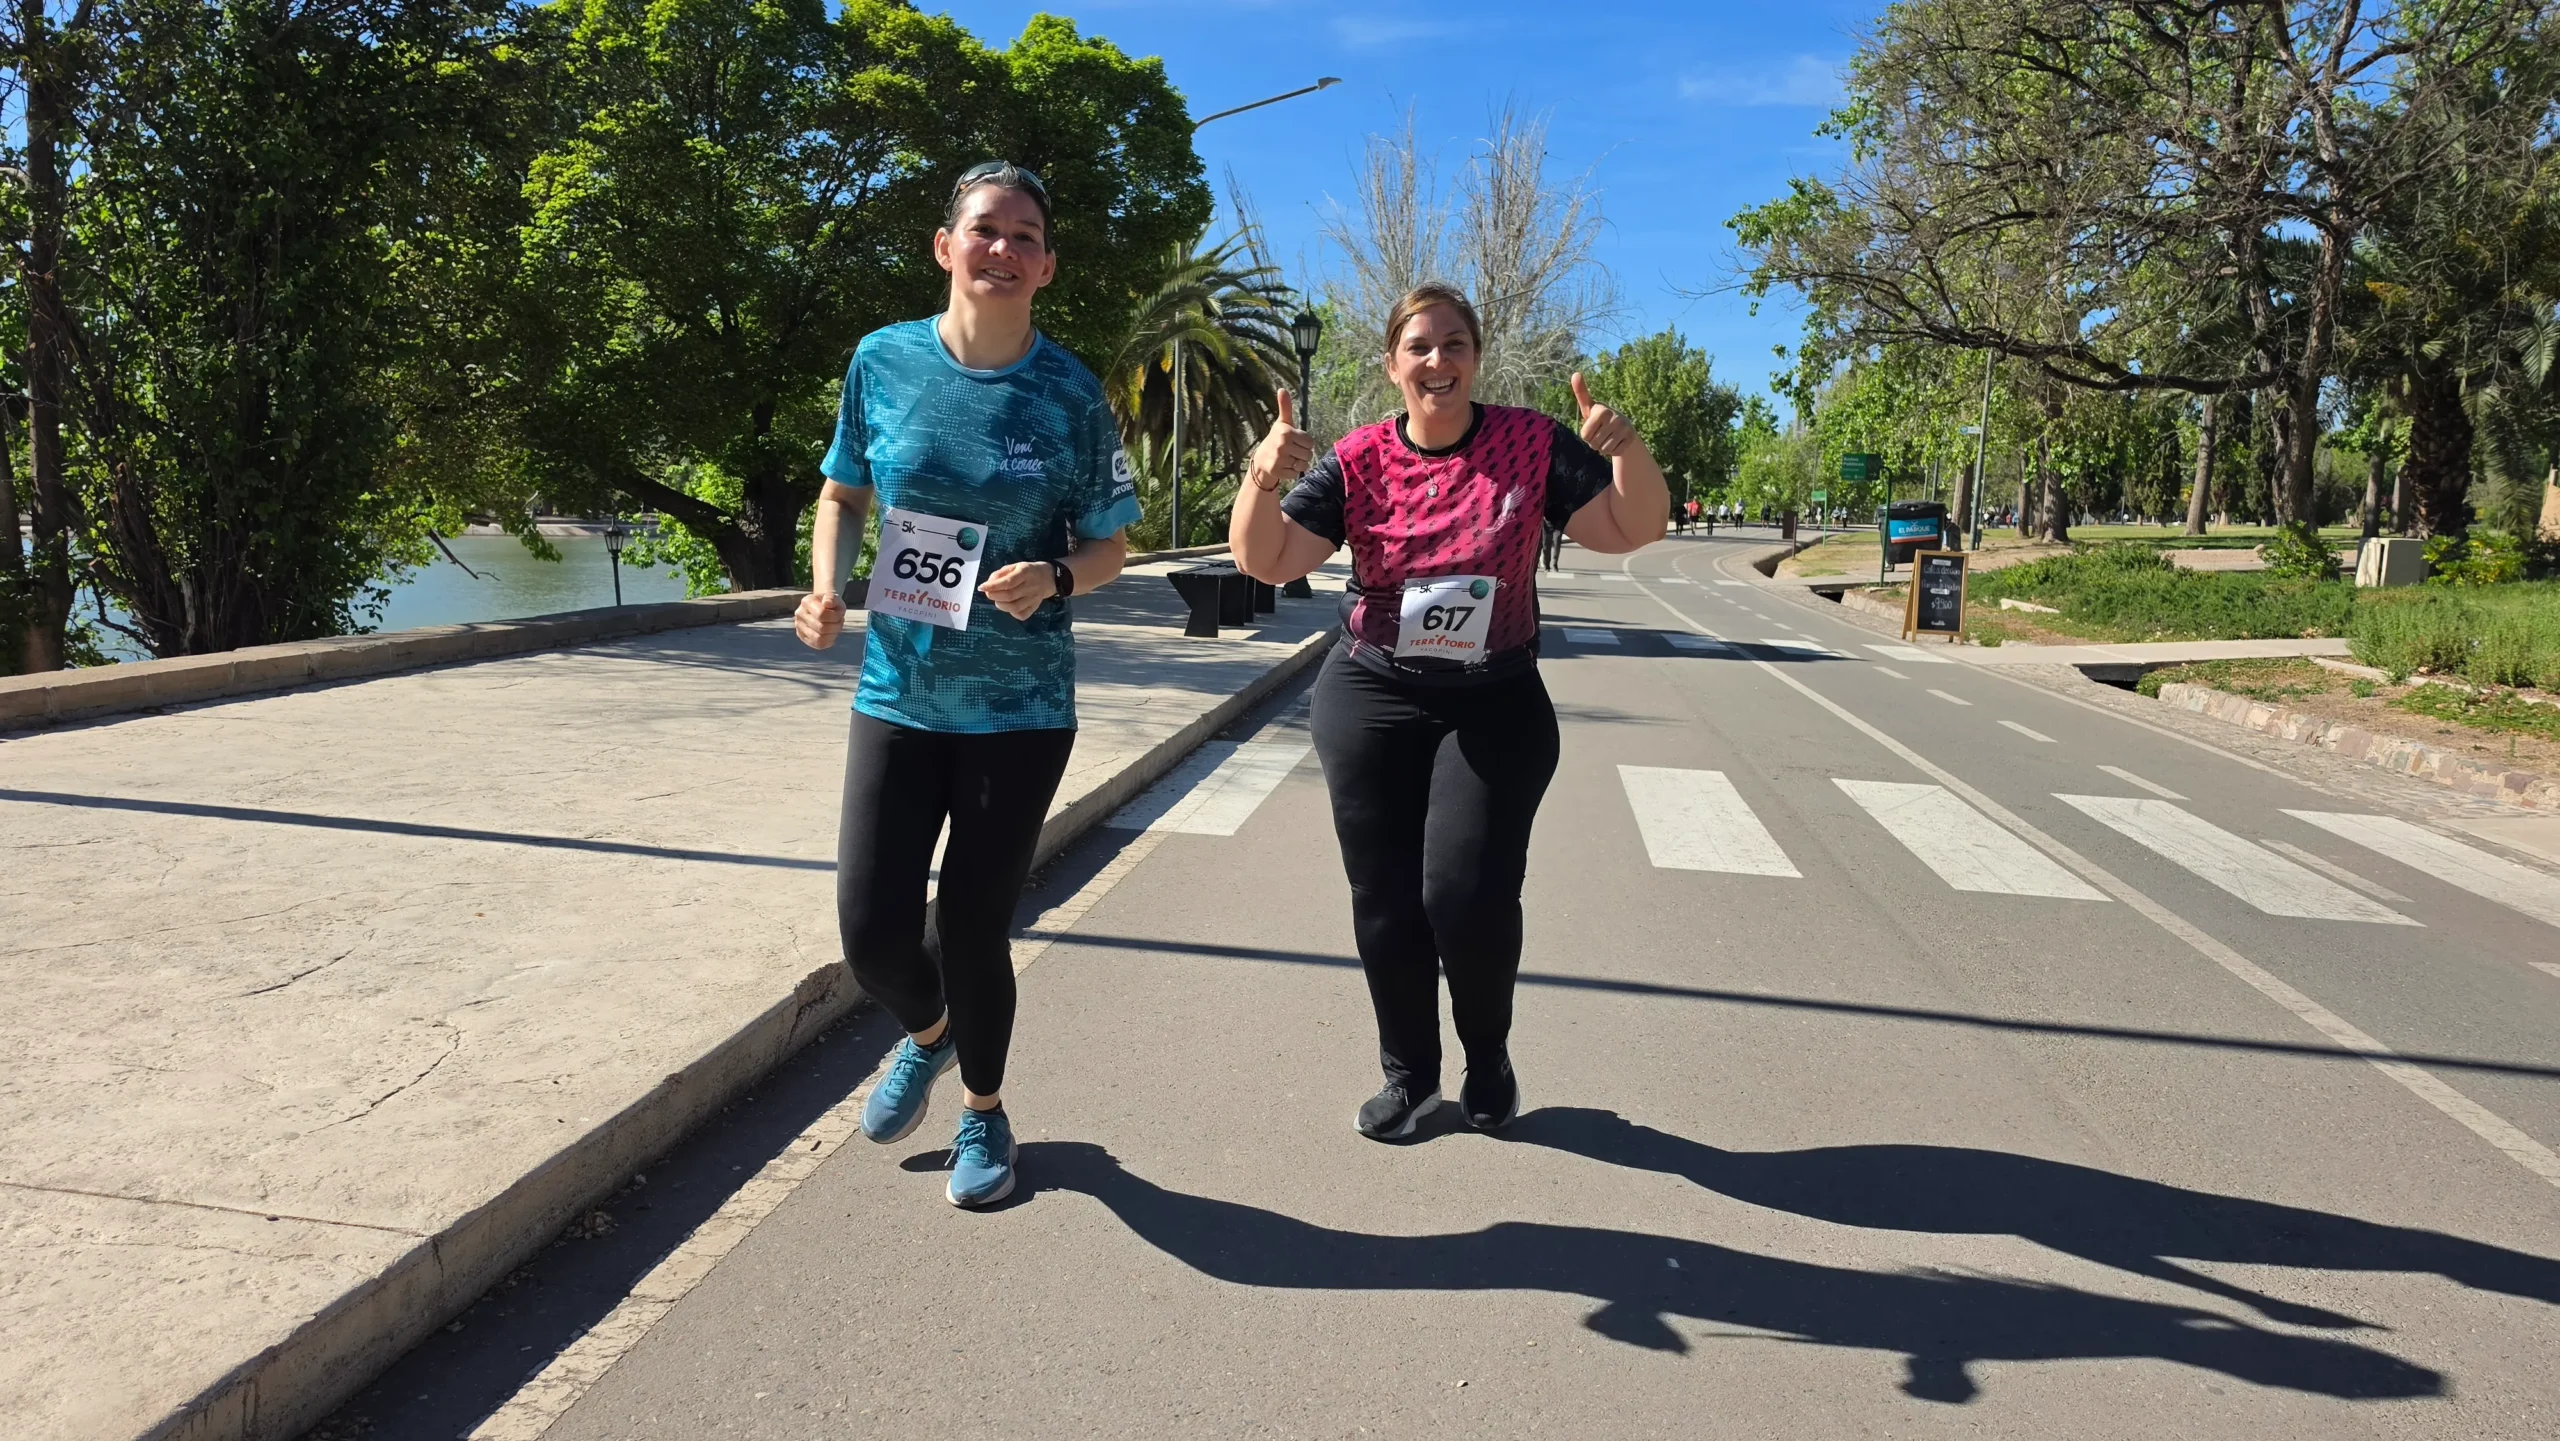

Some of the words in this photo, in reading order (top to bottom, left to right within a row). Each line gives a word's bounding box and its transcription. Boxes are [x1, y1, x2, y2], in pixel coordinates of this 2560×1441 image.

[999, 458, 1010, 471] a
[1906, 525, 1931, 533] PARQUE
[892, 547, 966, 589] 656
[897, 606, 937, 619] YACOPINI
[1422, 604, 1477, 632] 617
